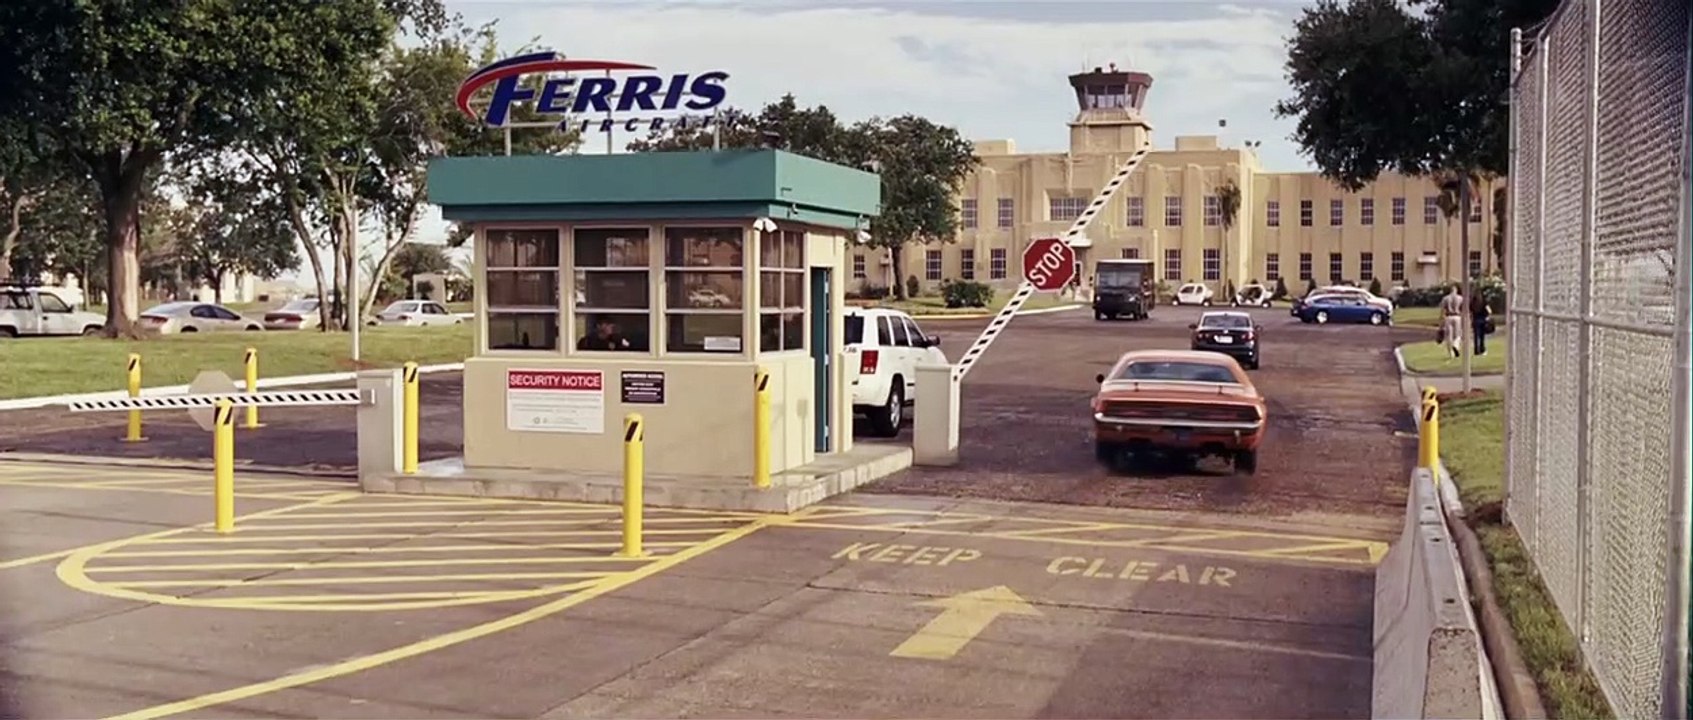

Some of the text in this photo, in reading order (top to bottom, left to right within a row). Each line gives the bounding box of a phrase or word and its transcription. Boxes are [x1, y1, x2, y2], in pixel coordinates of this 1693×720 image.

[466, 57, 730, 126] FERRIS
[556, 115, 738, 133] AIRCRAFT
[1029, 242, 1065, 286] STOP
[510, 374, 600, 387] SECURITY NOTICE
[831, 542, 1237, 588] KEEP CLEAR
